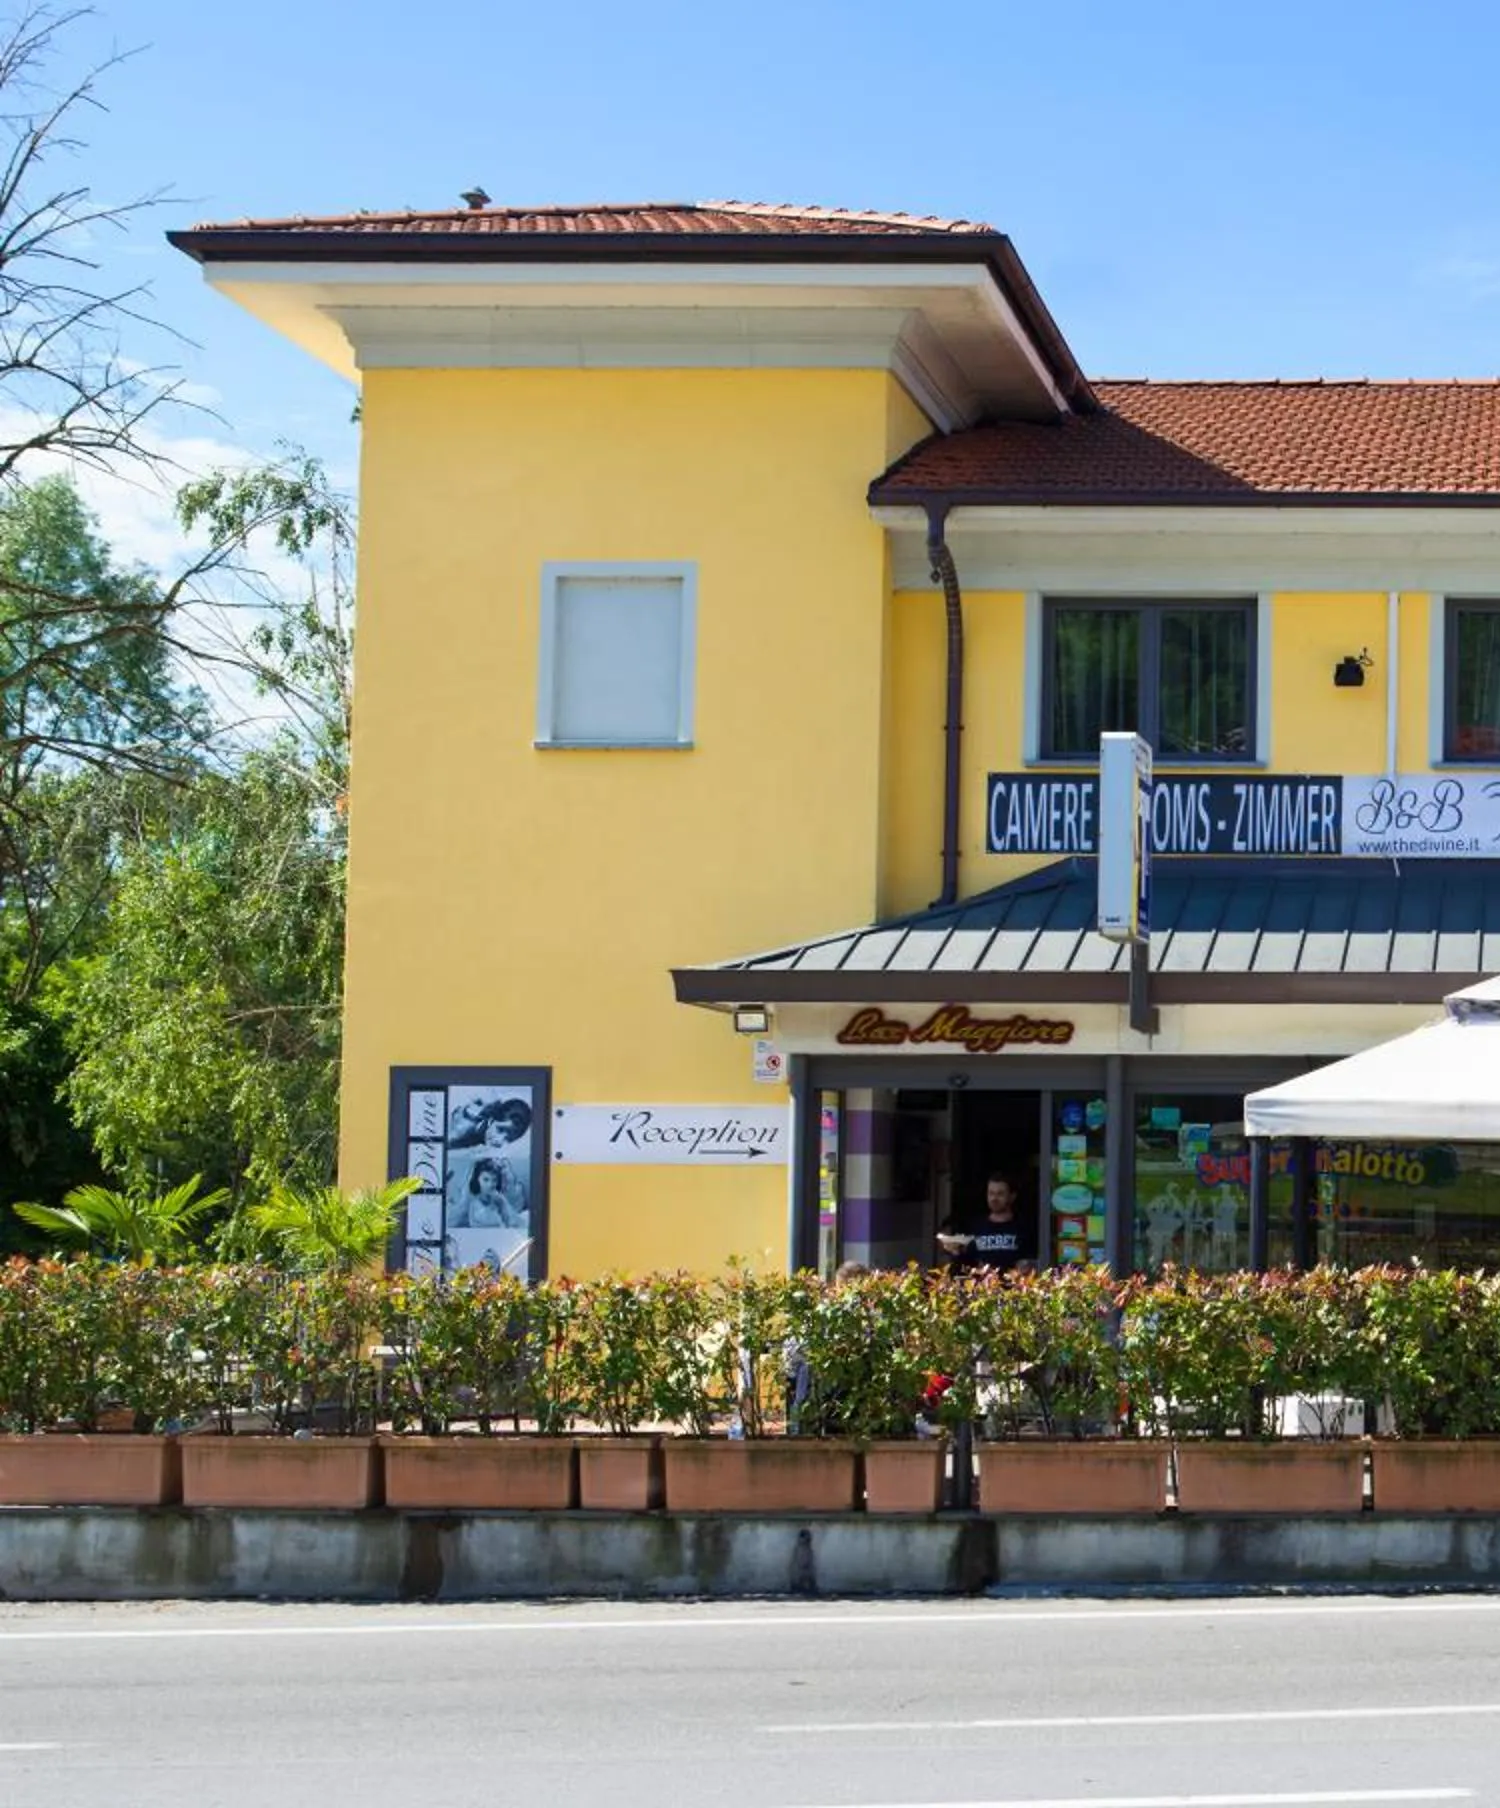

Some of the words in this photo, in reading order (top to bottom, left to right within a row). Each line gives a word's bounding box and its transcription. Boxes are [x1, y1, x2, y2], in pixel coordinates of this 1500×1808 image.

[990, 782, 1093, 852] CAMERE
[1152, 782, 1211, 852] OMS
[1233, 783, 1337, 853] ZIMMER
[1356, 779, 1464, 834] B&B
[1358, 838, 1480, 852] www.thedivine.it
[910, 1004, 1074, 1053] Maggiore
[609, 1111, 780, 1155] Reception
